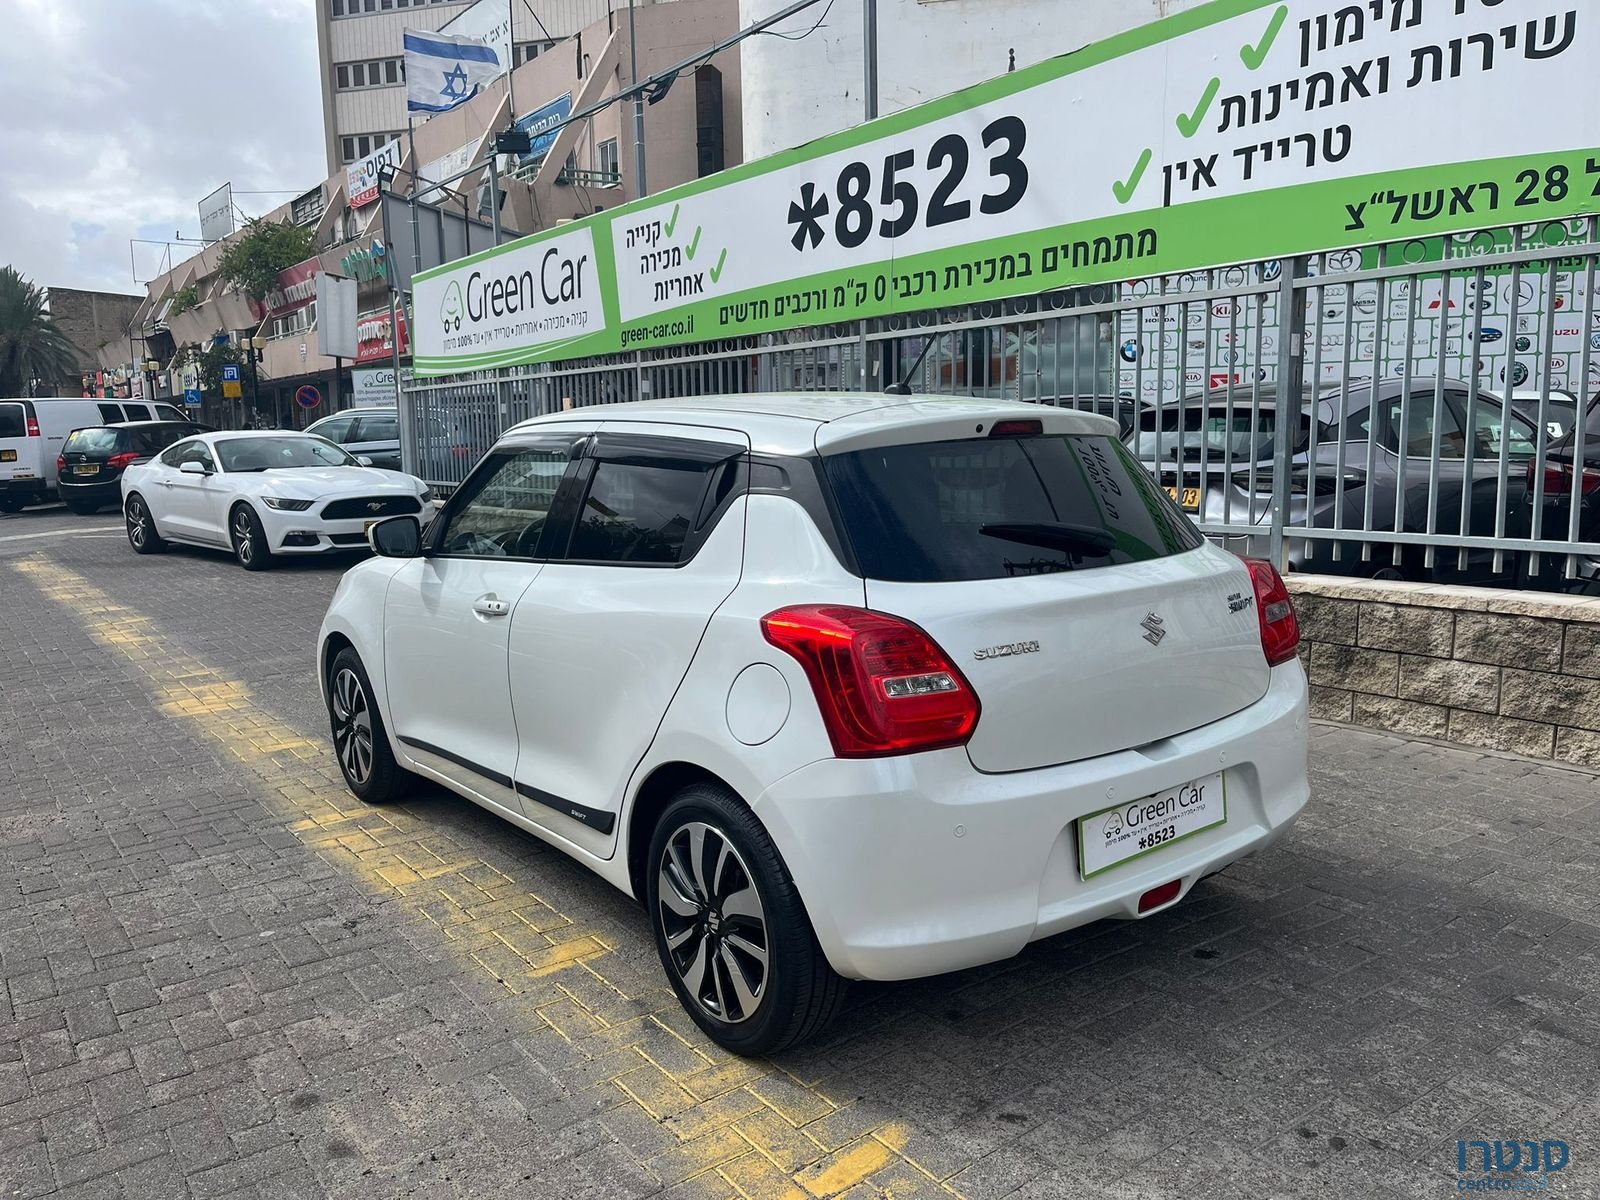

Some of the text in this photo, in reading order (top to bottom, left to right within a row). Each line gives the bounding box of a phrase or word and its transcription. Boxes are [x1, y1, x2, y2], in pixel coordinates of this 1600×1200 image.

[1217, 10, 1577, 133] שירות ואמינות
[1162, 124, 1352, 207] טרייד אין
[1514, 165, 1569, 207] 28
[626, 220, 661, 248] קנייה
[641, 246, 681, 275] מכירה
[1041, 229, 1158, 272] מתמחים
[466, 247, 587, 322] Green Car
[891, 270, 937, 298] רכבי
[943, 252, 1032, 290] במכירת
[654, 273, 704, 302] אחריות
[774, 287, 828, 313] ורכבים
[874, 277, 886, 301] 0
[544, 315, 565, 331] מכירה
[571, 311, 588, 328] קניה
[719, 297, 769, 325] חדשים
[457, 335, 473, 347] 100%
[621, 315, 695, 347] green-car.co.il
[1554, 328, 1579, 336] UZU
[375, 371, 396, 384] Gre
[973, 640, 1040, 661] SUZUKI
[1126, 785, 1205, 828] Green Car
